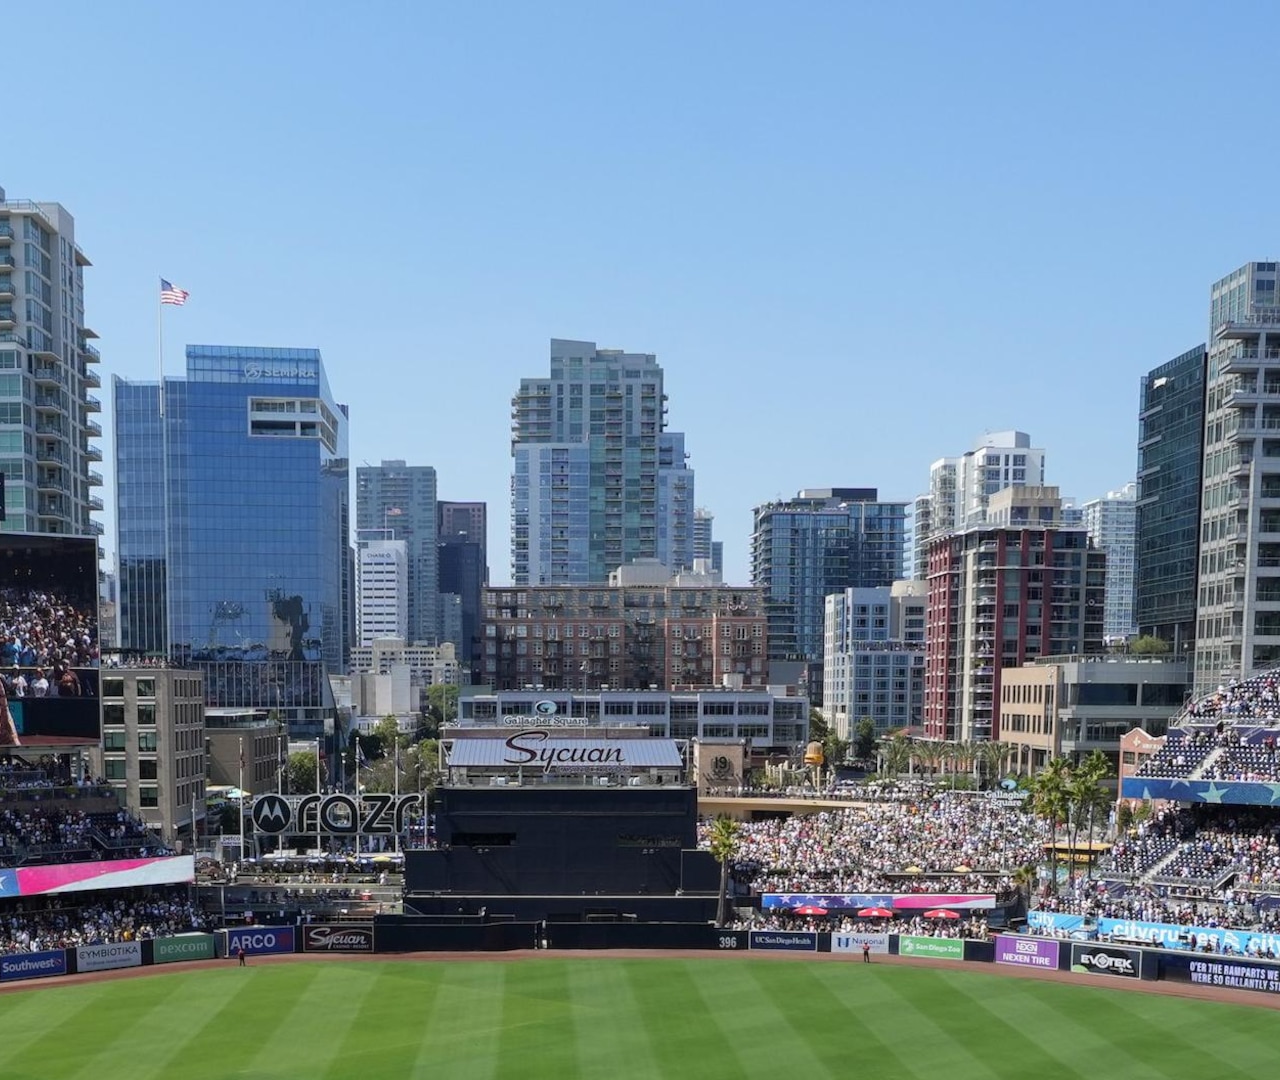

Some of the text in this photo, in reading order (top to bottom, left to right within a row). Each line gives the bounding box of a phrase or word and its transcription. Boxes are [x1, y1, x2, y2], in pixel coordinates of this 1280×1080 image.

[264, 367, 316, 378] SEMPRA
[505, 716, 588, 727] Gallagher Square
[504, 730, 625, 773] Sycuan
[715, 756, 727, 769] 19
[985, 790, 1028, 807] Gallagher Square
[296, 793, 421, 834] razr
[231, 934, 276, 949] ARCO
[309, 928, 368, 949] Sycuan
[720, 936, 737, 948] 396
[755, 936, 811, 946] UC San Diego Health
[852, 937, 885, 946] National
[79, 946, 138, 960] CYMBIOTIKA
[916, 942, 932, 950] San
[932, 944, 947, 953] Diego
[2, 958, 55, 973] Southwest
[1003, 953, 1051, 966] NEXEN TIRE
[1081, 953, 1132, 969] EVOTEK
[1189, 961, 1207, 972] O'ER
[1208, 963, 1222, 974] THE
[1224, 965, 1265, 979] RAMPARTS
[1267, 969, 1279, 980] WE
[1191, 972, 1212, 983] WERE
[1213, 974, 1224, 985] SO
[1225, 975, 1268, 990] GALLANTLY
